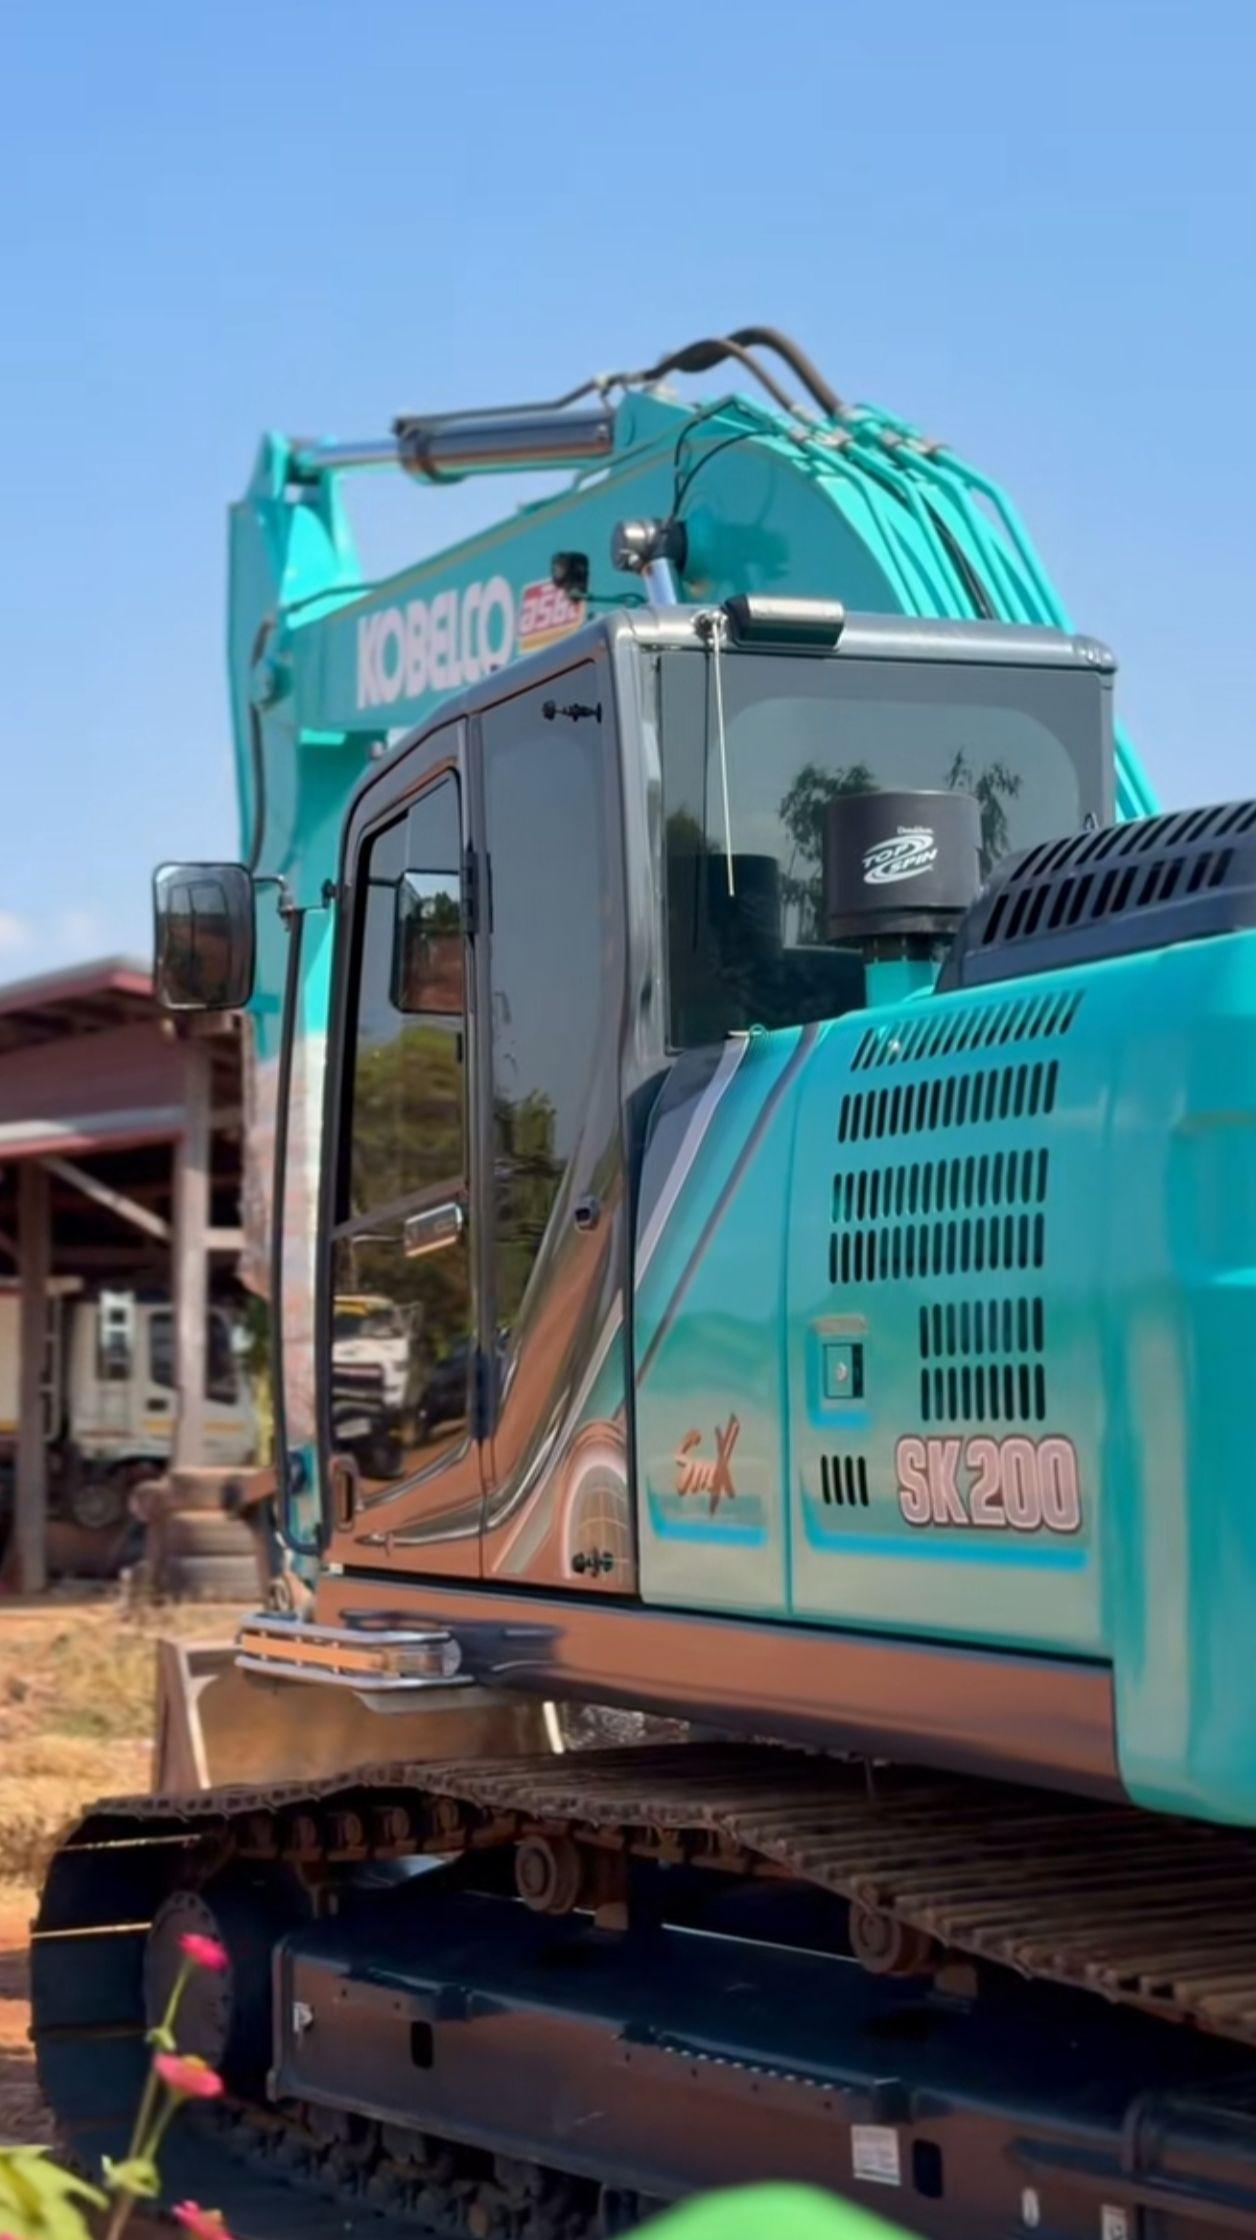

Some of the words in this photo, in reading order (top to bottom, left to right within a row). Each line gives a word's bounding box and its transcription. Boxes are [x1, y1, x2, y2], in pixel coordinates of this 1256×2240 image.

[357, 575, 514, 710] KOBELCO
[863, 843, 911, 868] TOP
[890, 848, 938, 873] SPIN
[896, 1435, 1081, 1532] SK200
